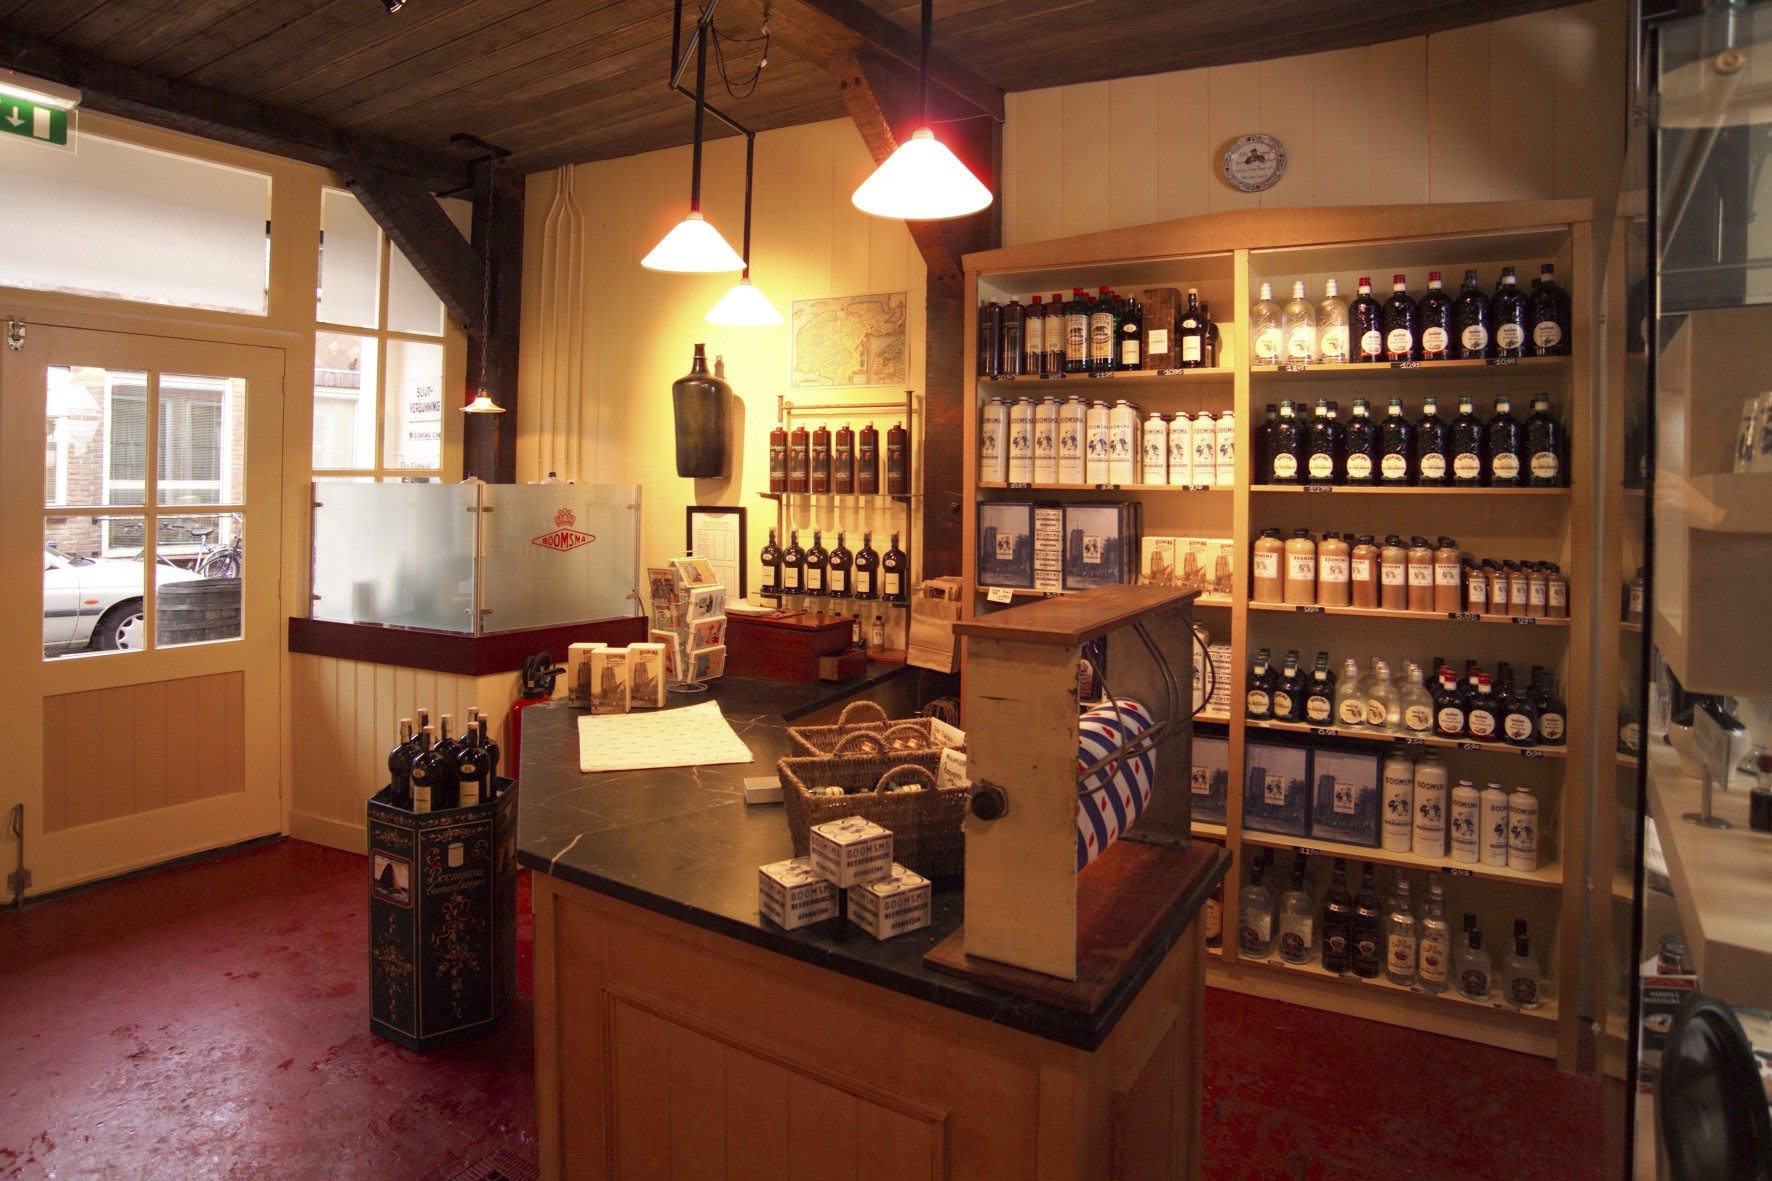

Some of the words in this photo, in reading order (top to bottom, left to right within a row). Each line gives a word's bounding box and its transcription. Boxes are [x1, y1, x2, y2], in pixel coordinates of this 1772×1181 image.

[542, 532, 586, 549] BOOMSMA
[846, 839, 890, 860] BOOMSMA
[846, 852, 890, 869] BEERENBURGER
[884, 891, 928, 911] BOOMSMA
